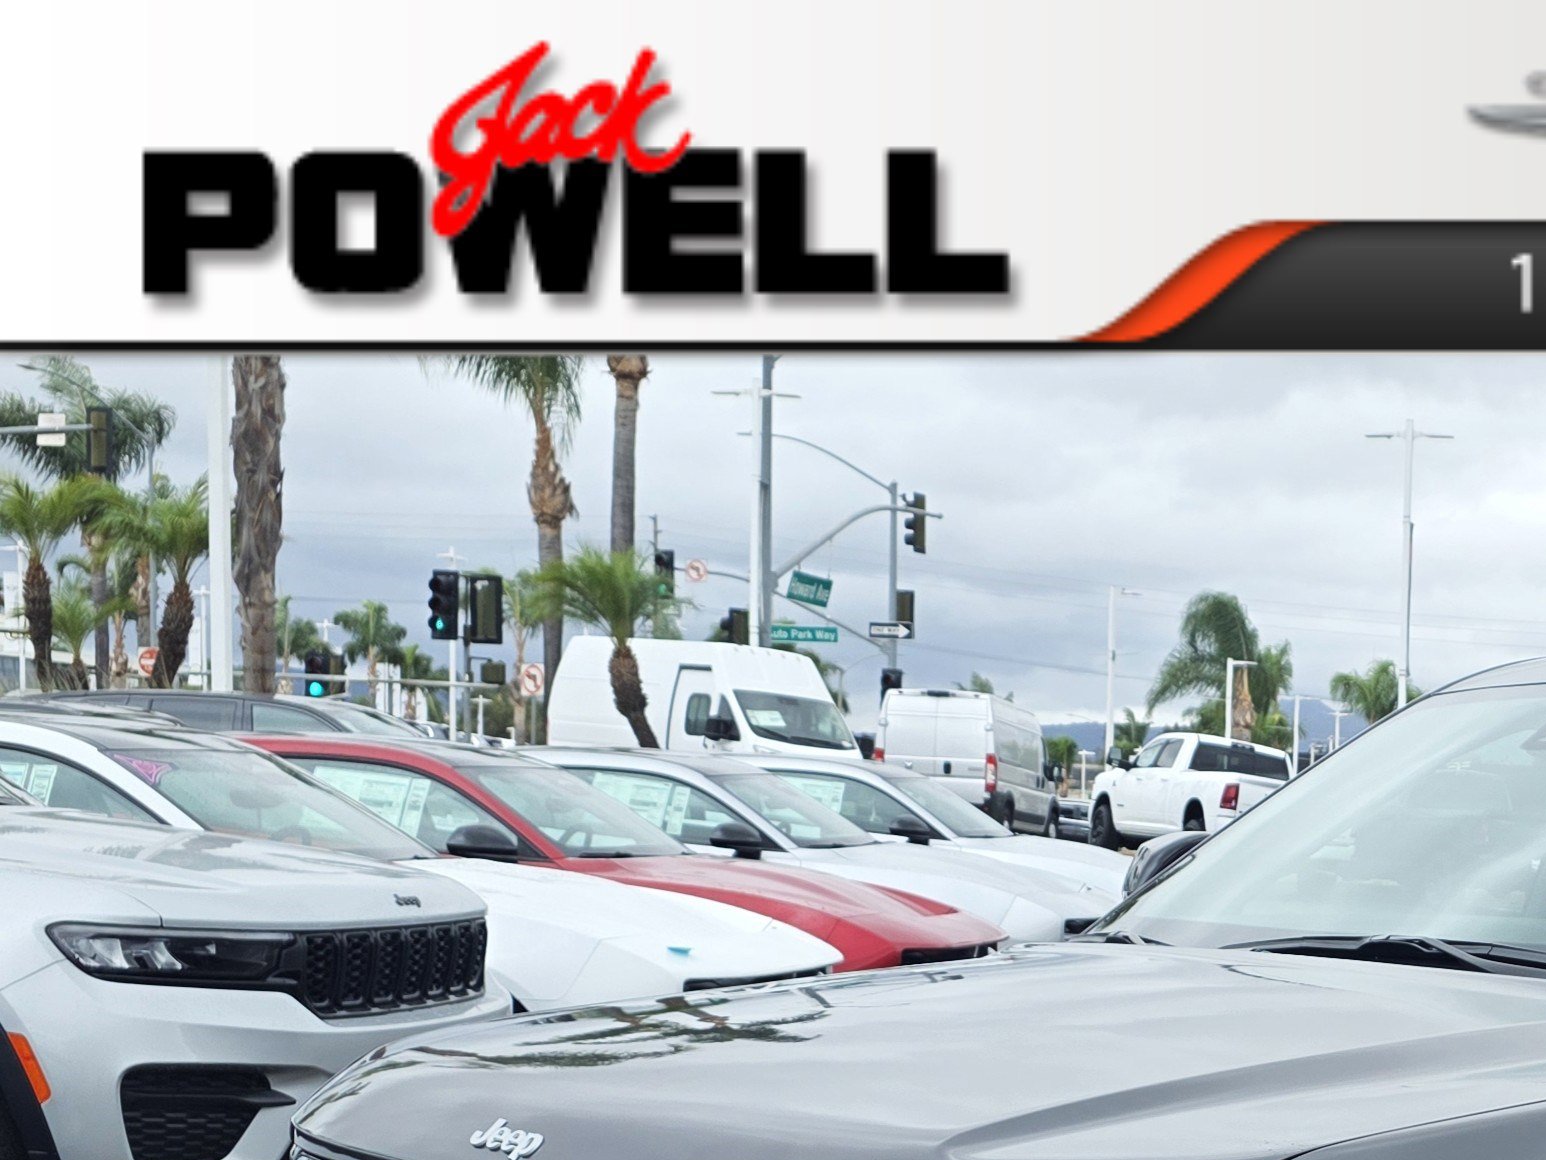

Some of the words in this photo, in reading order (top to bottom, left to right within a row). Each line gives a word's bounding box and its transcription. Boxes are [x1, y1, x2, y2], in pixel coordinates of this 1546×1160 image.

[771, 629, 789, 639] uto
[790, 629, 813, 640] Park
[815, 629, 836, 641] Way
